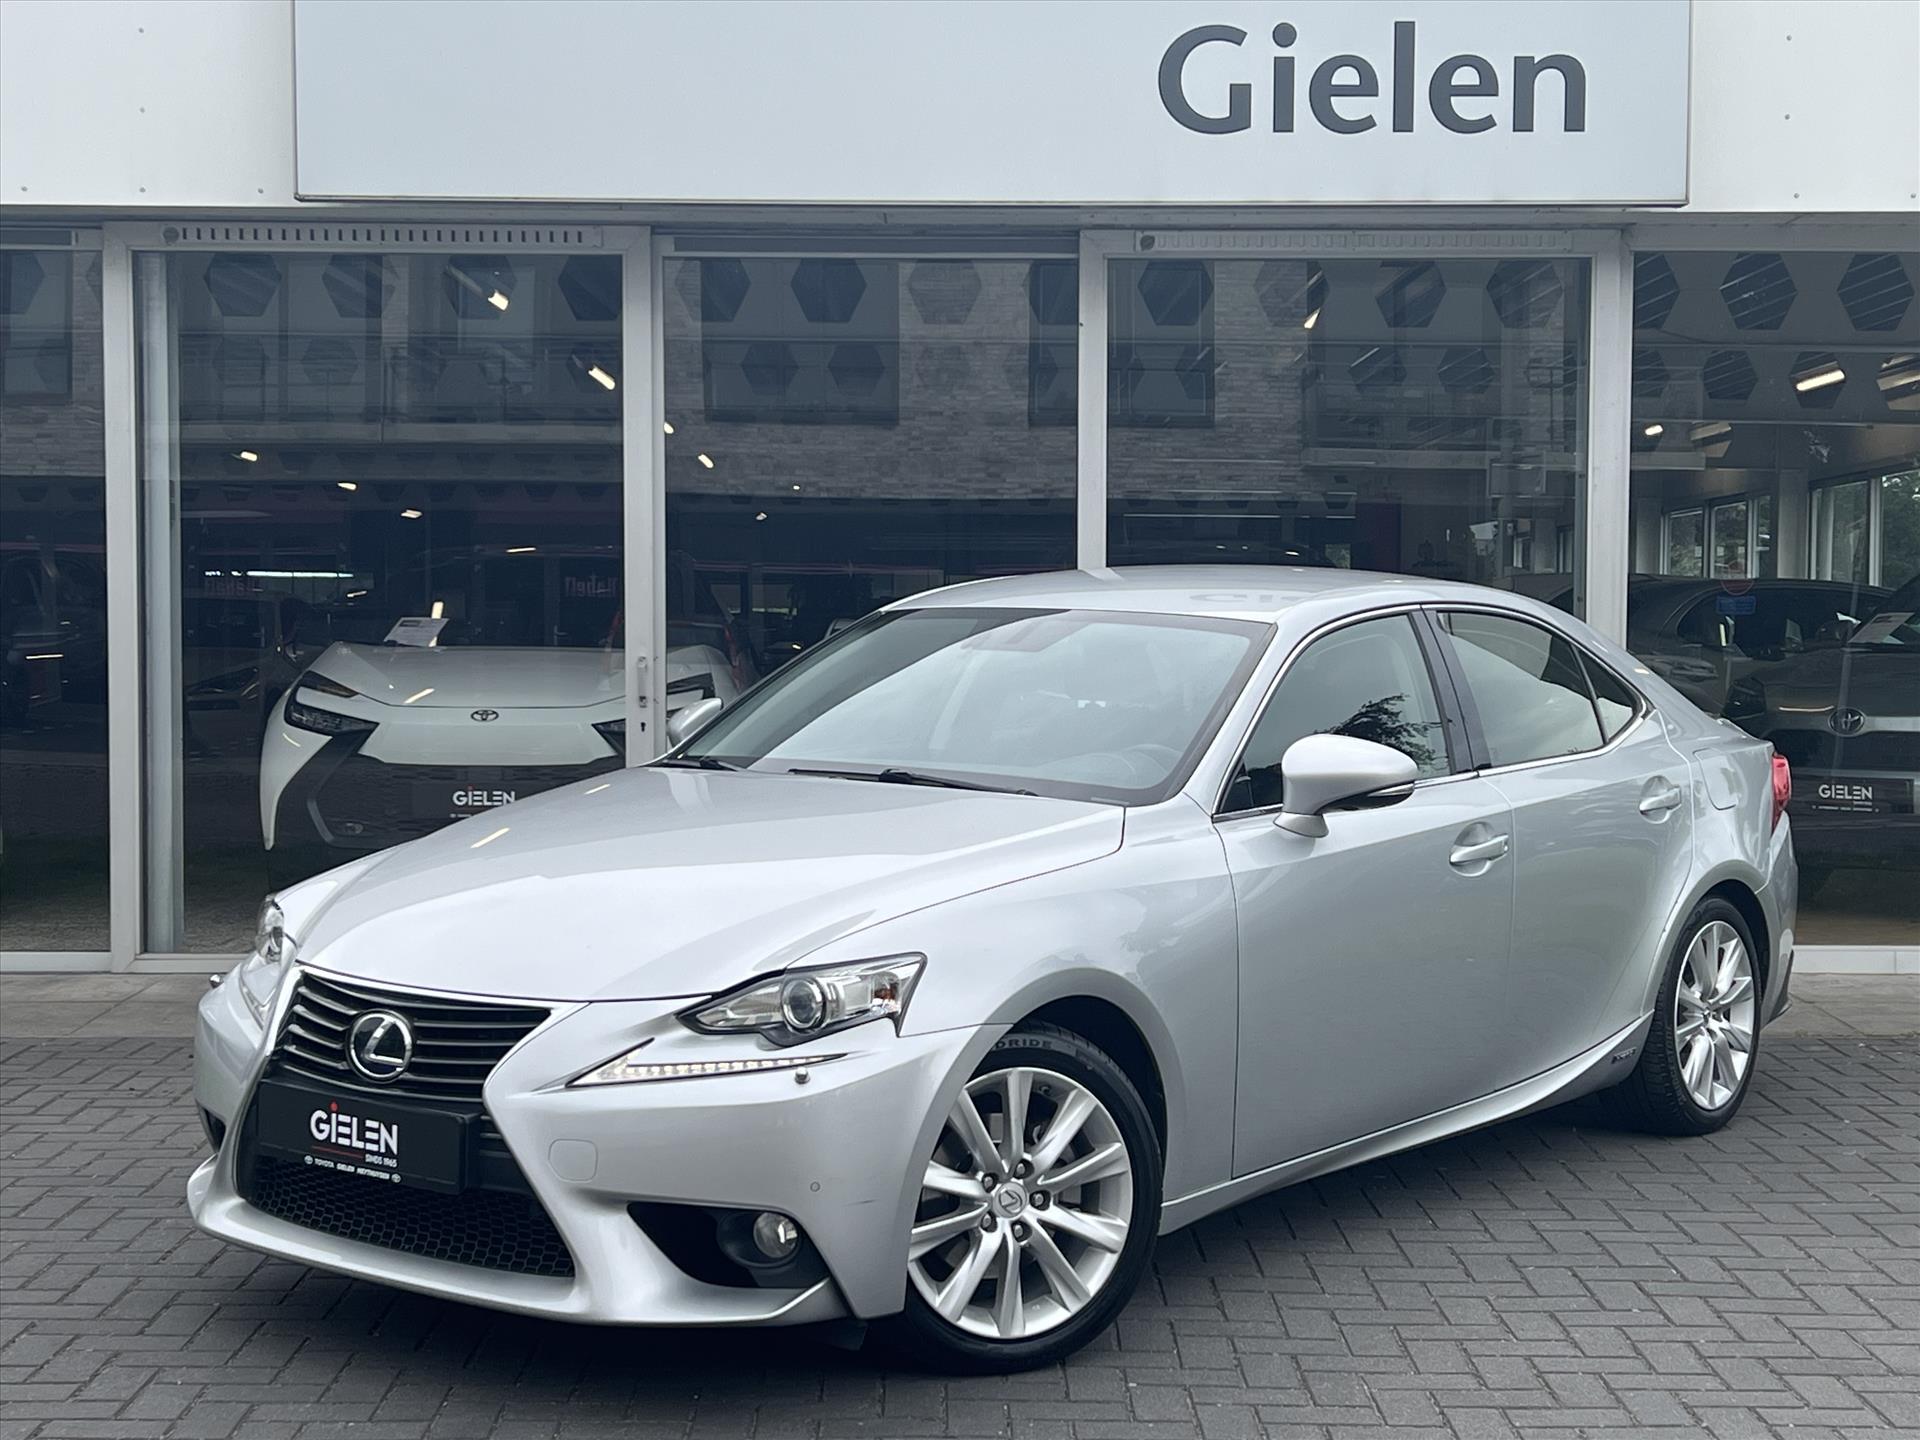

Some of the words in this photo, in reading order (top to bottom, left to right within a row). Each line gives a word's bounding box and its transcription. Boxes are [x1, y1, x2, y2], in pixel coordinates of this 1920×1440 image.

[1158, 21, 1586, 135] Gielen
[452, 785, 516, 806] GIELEN
[1818, 784, 1873, 800] GIELEN
[310, 1101, 398, 1156] GIELEN
